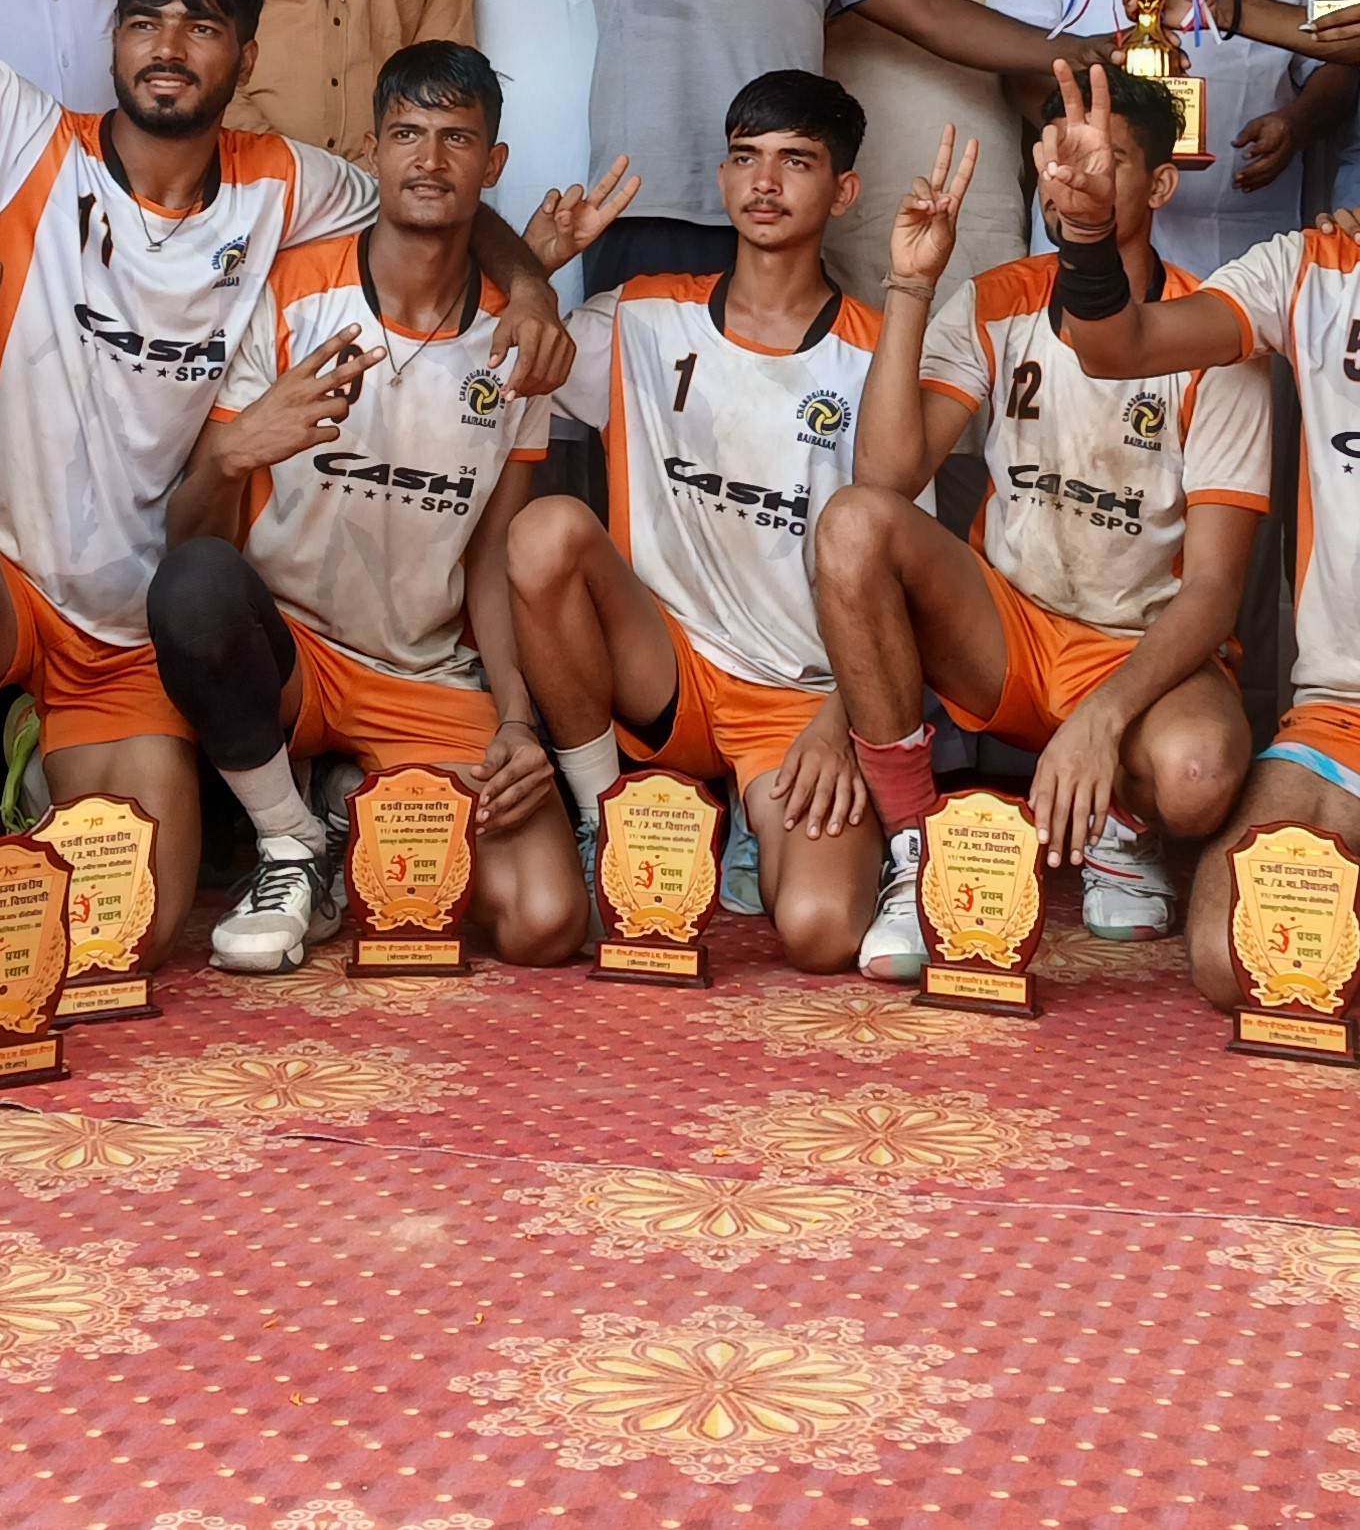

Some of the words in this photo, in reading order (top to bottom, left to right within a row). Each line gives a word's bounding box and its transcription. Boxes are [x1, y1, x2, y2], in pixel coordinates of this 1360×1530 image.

[74, 304, 226, 362] CASH
[175, 367, 223, 381] SPO
[673, 351, 698, 413] 1
[1006, 361, 1042, 420] 12
[313, 452, 475, 499] CASH
[458, 466, 478, 476] 34
[664, 457, 810, 519] CASH
[420, 497, 470, 516] SPO
[1008, 465, 1142, 518] CASH
[1124, 487, 1145, 498] 34
[755, 513, 807, 537] SPO
[1090, 512, 1142, 536] SPO
